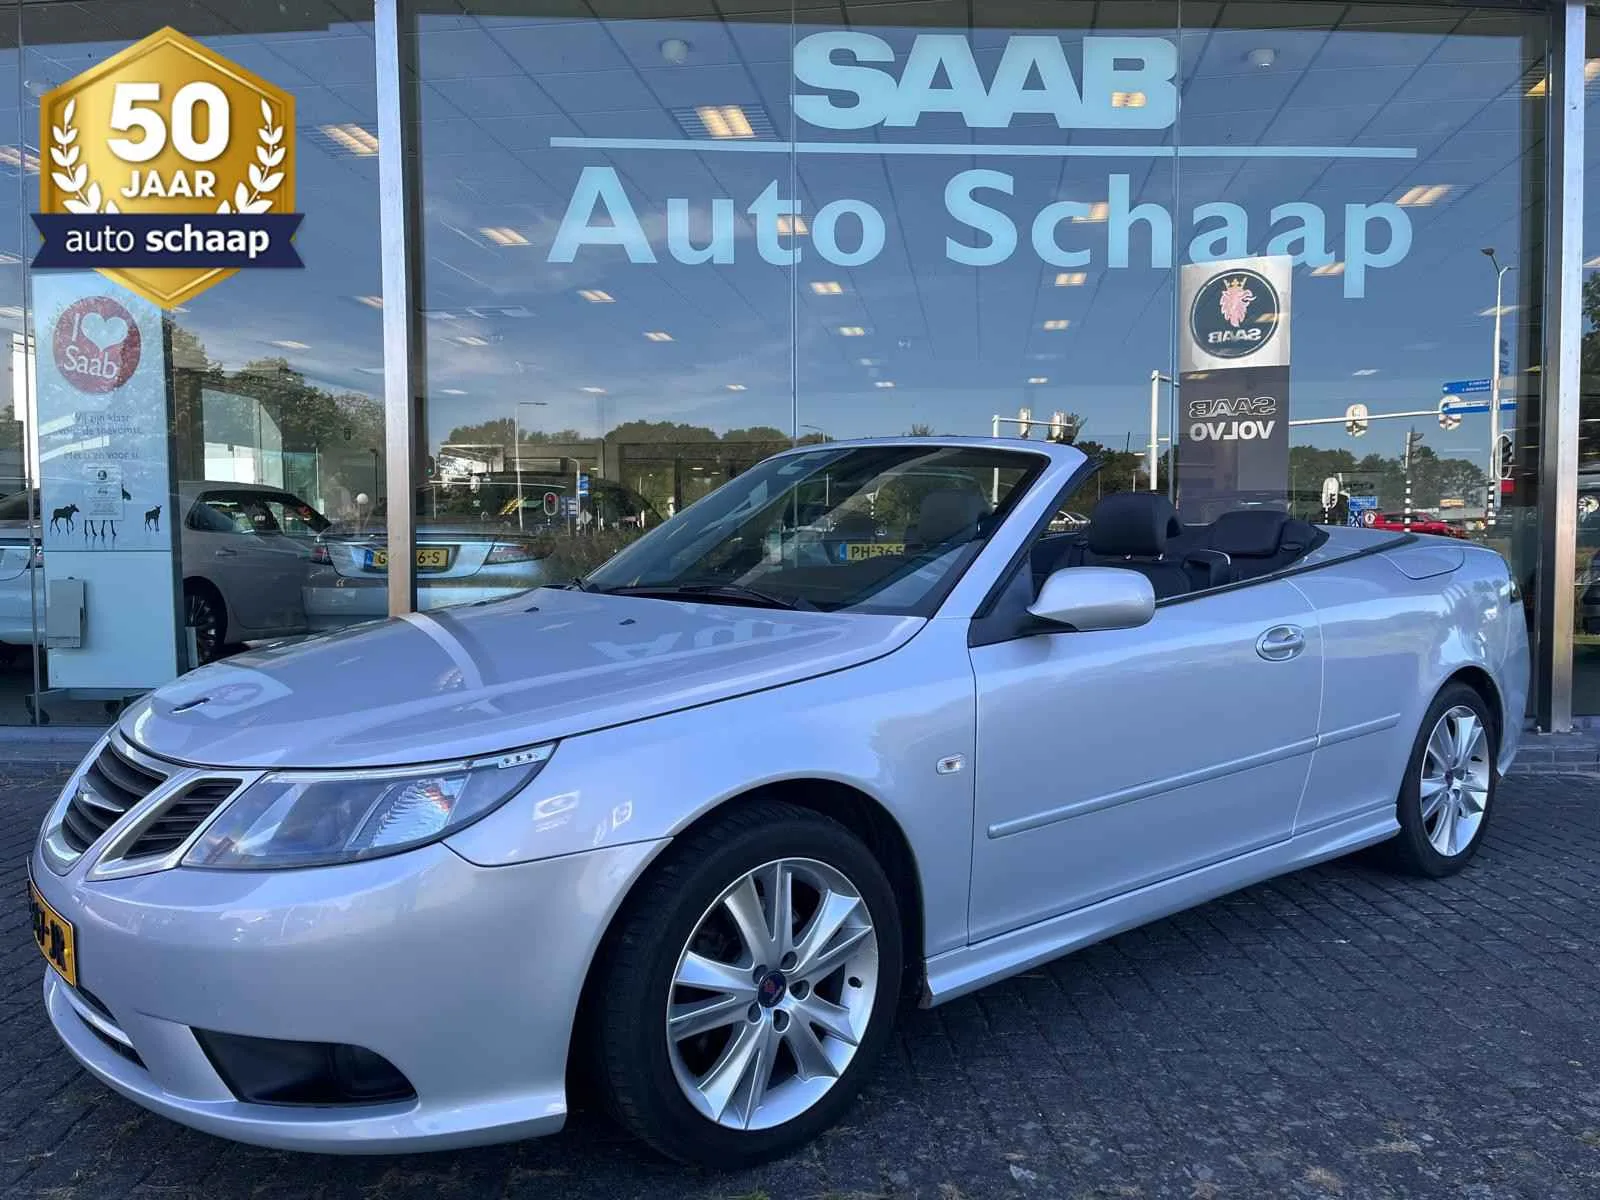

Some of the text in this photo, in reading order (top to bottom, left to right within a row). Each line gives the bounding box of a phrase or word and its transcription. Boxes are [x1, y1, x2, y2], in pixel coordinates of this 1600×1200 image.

[789, 31, 1179, 129] SAAB
[546, 167, 1413, 299] Auto Schaap
